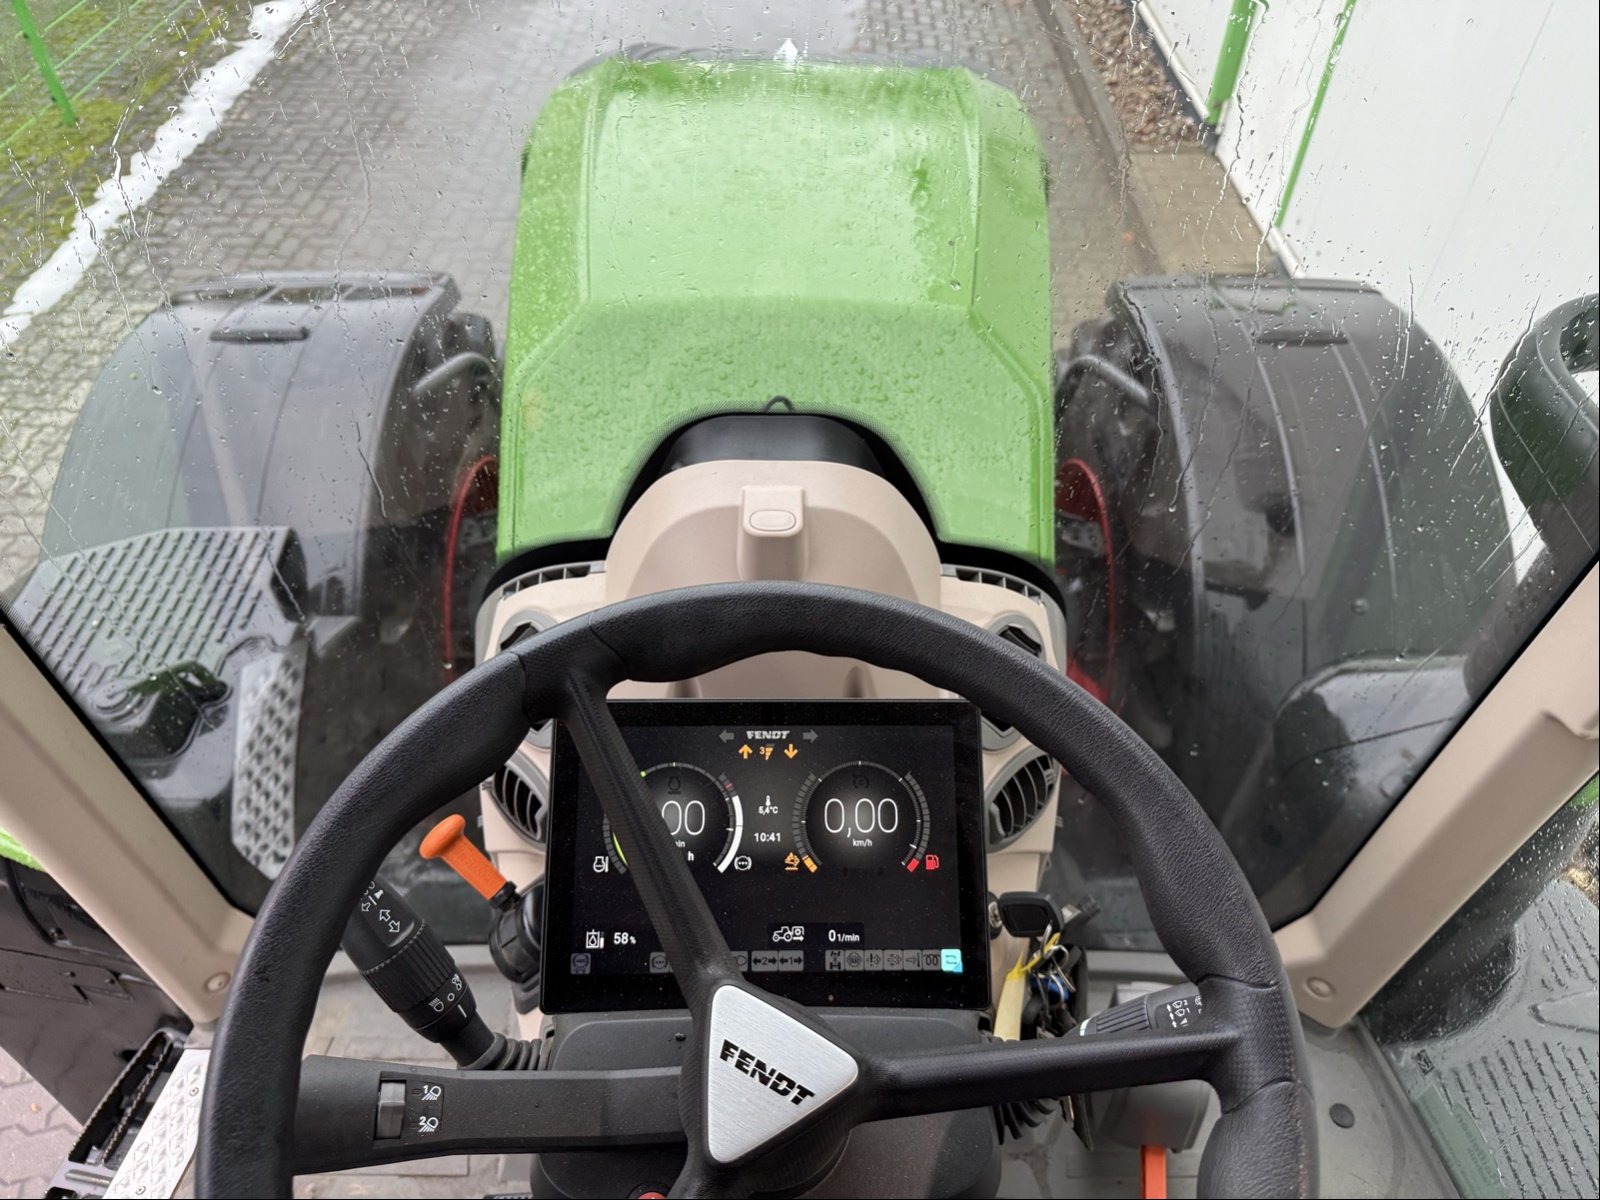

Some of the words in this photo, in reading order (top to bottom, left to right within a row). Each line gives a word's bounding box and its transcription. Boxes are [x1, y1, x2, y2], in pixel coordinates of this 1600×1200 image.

[746, 730, 790, 739] FENDT
[758, 805, 778, 816] 5,4°C
[824, 798, 898, 838] 0,00
[754, 832, 781, 842] 10:41
[852, 838, 873, 847] km/h
[837, 933, 860, 943] 1/min
[719, 1038, 816, 1106] FENDT
[422, 1085, 429, 1094] 1
[419, 1116, 426, 1126] 2
